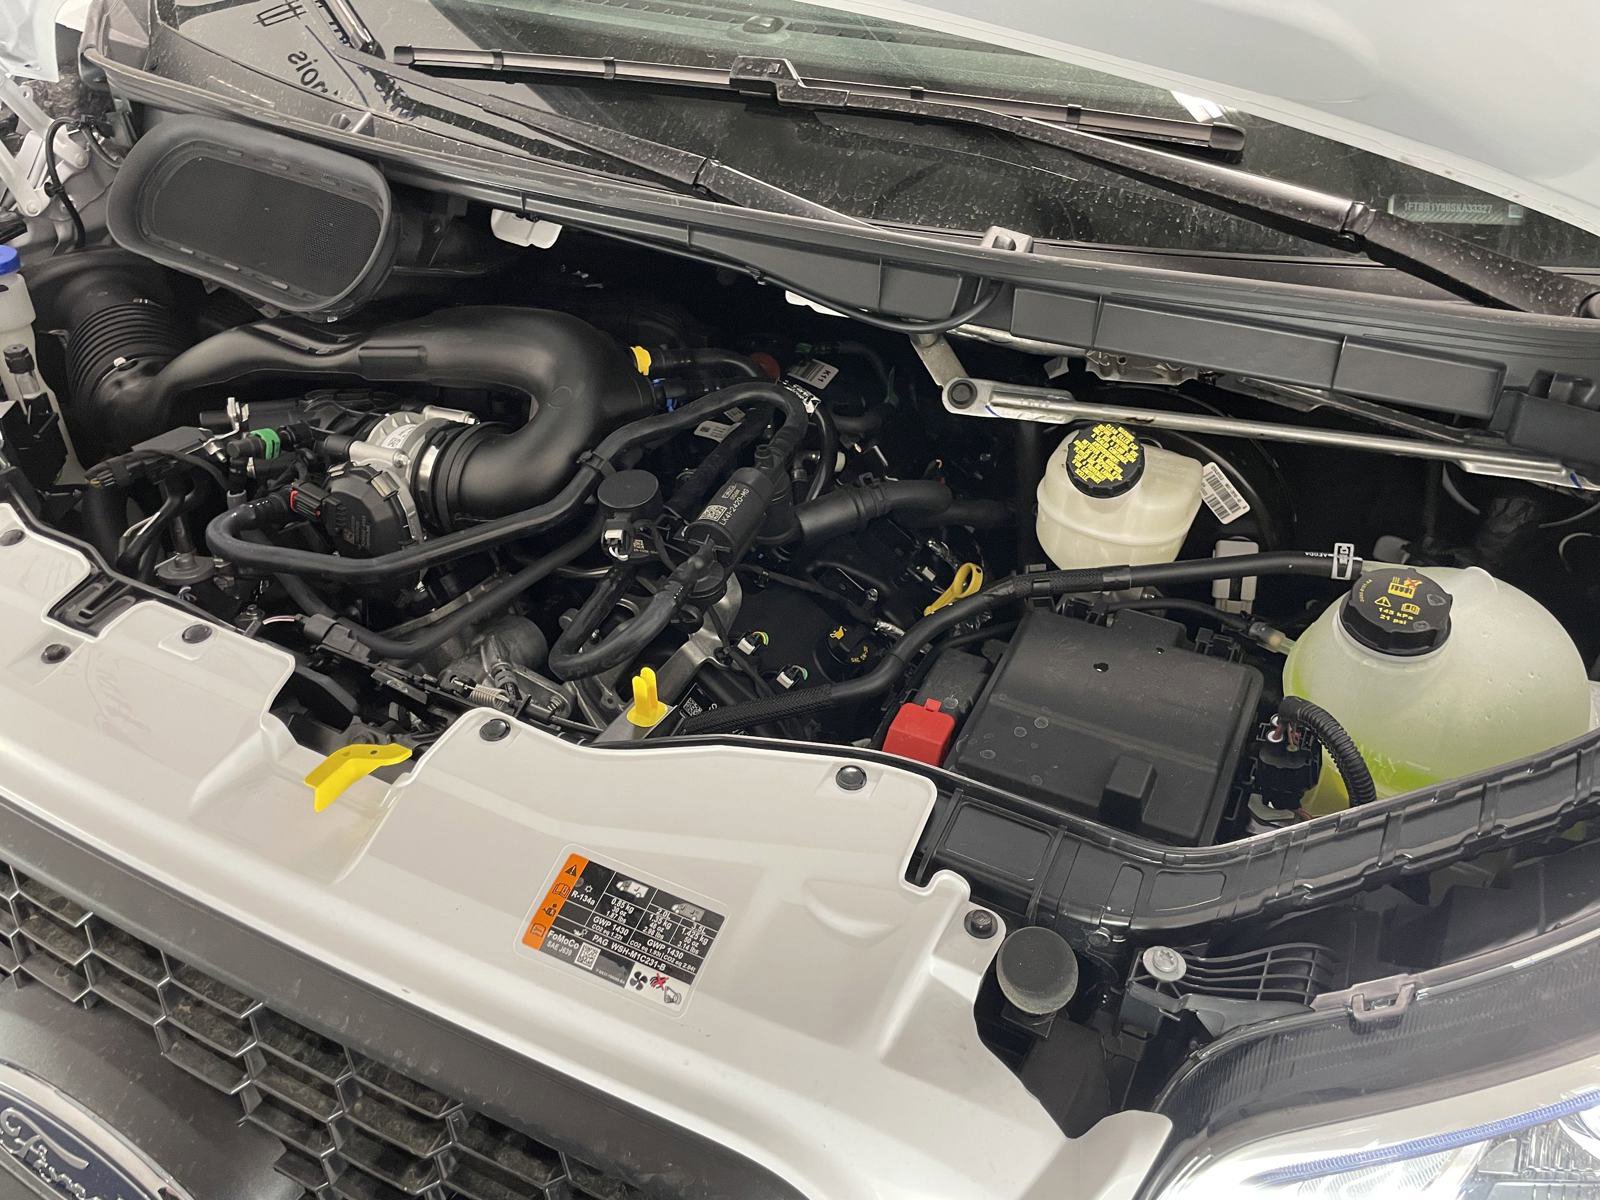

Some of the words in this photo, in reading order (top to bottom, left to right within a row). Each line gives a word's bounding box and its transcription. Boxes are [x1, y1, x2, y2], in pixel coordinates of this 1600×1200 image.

[570, 889, 596, 905] R-134a
[623, 902, 636, 914] kg
[590, 923, 604, 932] CO2
[591, 915, 612, 928] GWP
[610, 923, 630, 936] 1430
[661, 919, 673, 930] kg
[546, 929, 581, 949] FoMoCo
[591, 933, 609, 946] PAG
[697, 935, 709, 945] kg
[645, 938, 666, 952] GWP
[665, 946, 685, 959] 1430
